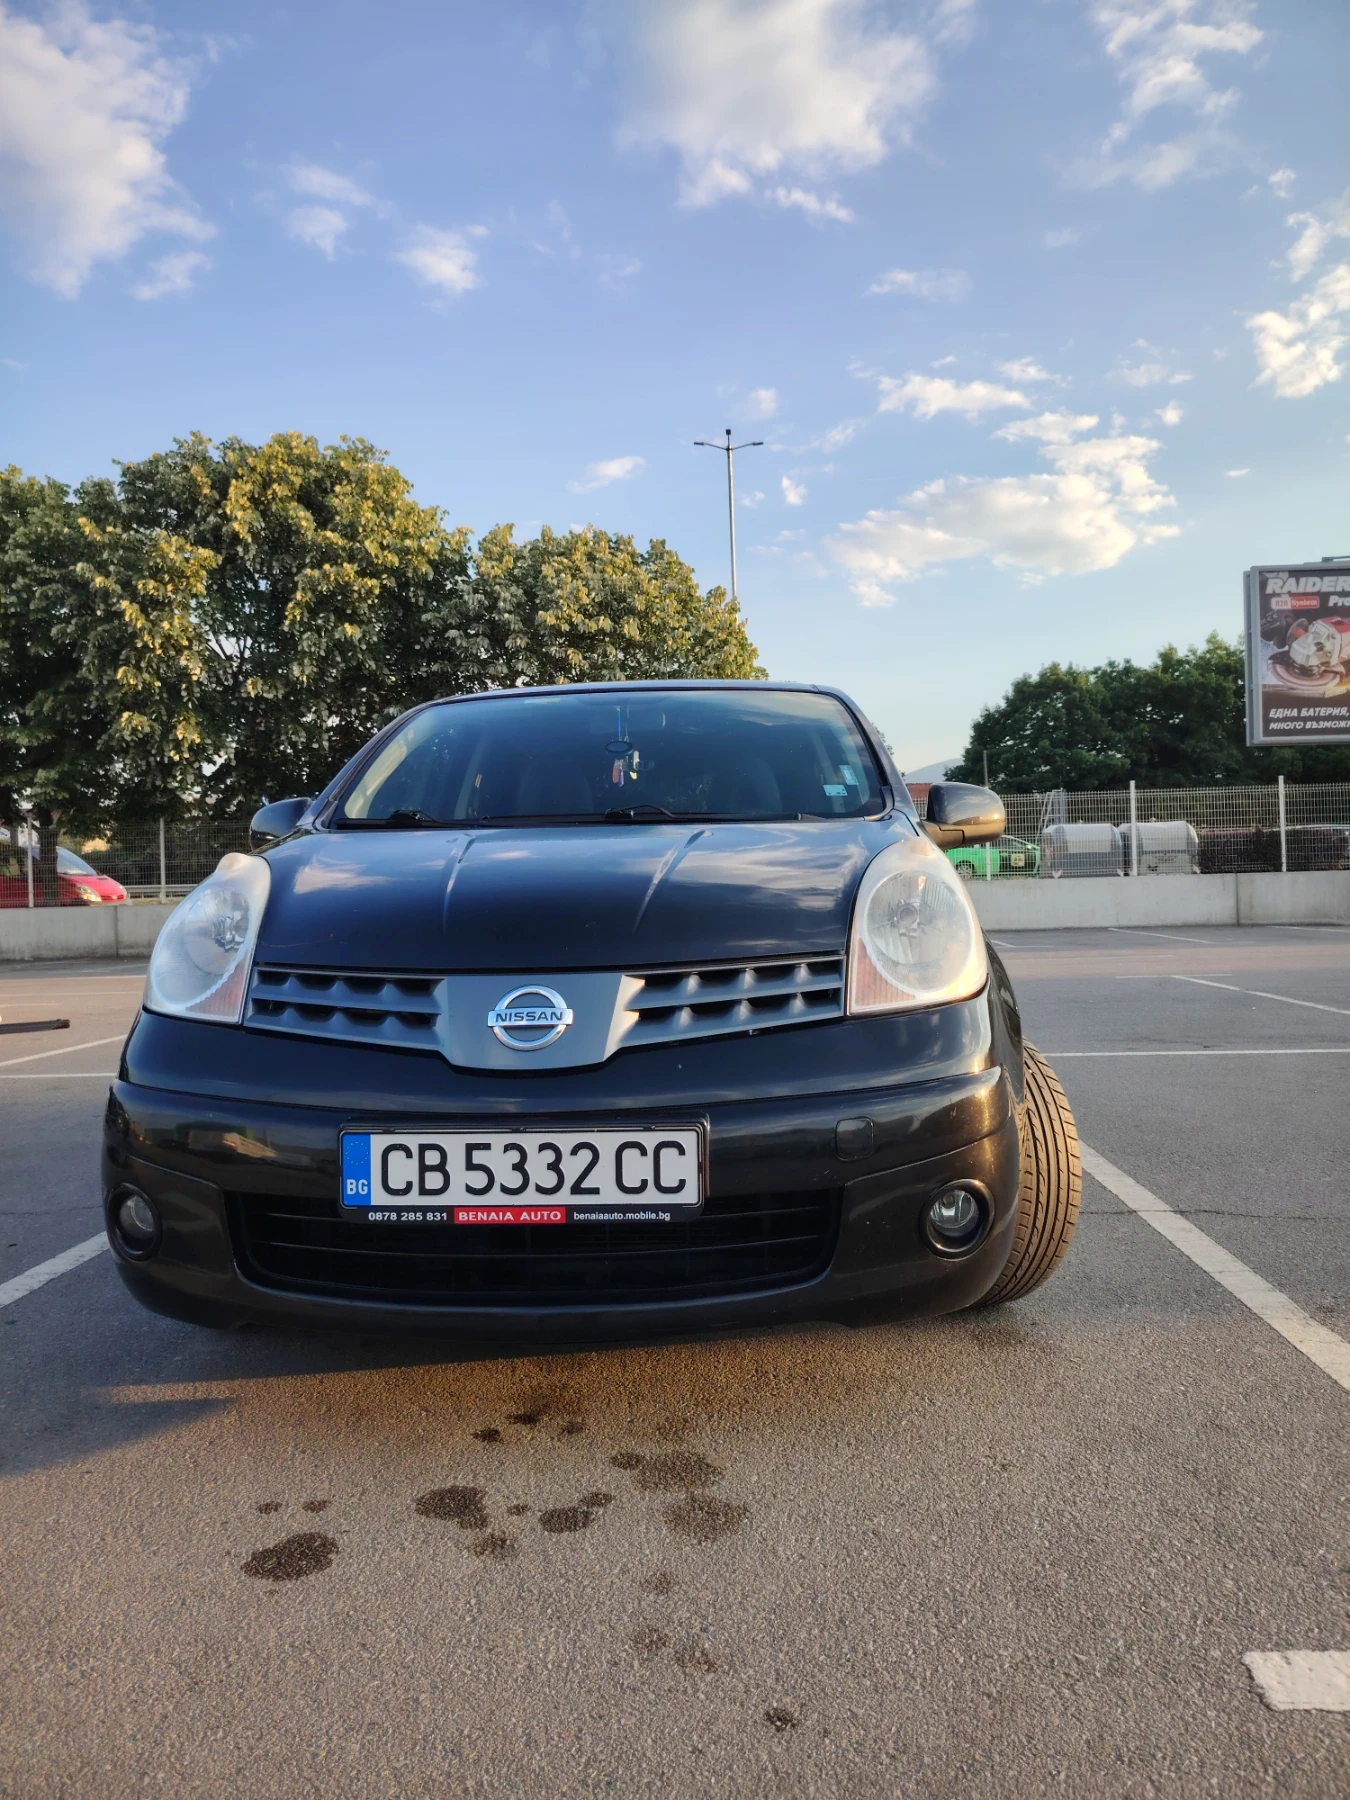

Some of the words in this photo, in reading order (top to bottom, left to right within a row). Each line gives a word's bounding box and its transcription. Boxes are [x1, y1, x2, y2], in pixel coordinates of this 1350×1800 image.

[1265, 575, 1350, 594] RAIDER
[1291, 599, 1318, 608] System
[1269, 708, 1298, 718] ЕДНА
[1300, 706, 1349, 717] БАТЕРИЯ,
[1269, 721, 1304, 730] МНОГО
[495, 1011, 563, 1022] NISSAN
[381, 1143, 450, 1196] CB
[465, 1142, 601, 1196] 5332
[615, 1140, 687, 1194] CC
[346, 1178, 369, 1195] BG
[368, 1212, 397, 1221] 0878
[401, 1212, 423, 1220] 285
[426, 1212, 447, 1220] 831
[458, 1211, 514, 1221] BENAIA
[520, 1211, 561, 1220] AUTO
[573, 1211, 671, 1221] benaiaauto.mobile.bg
